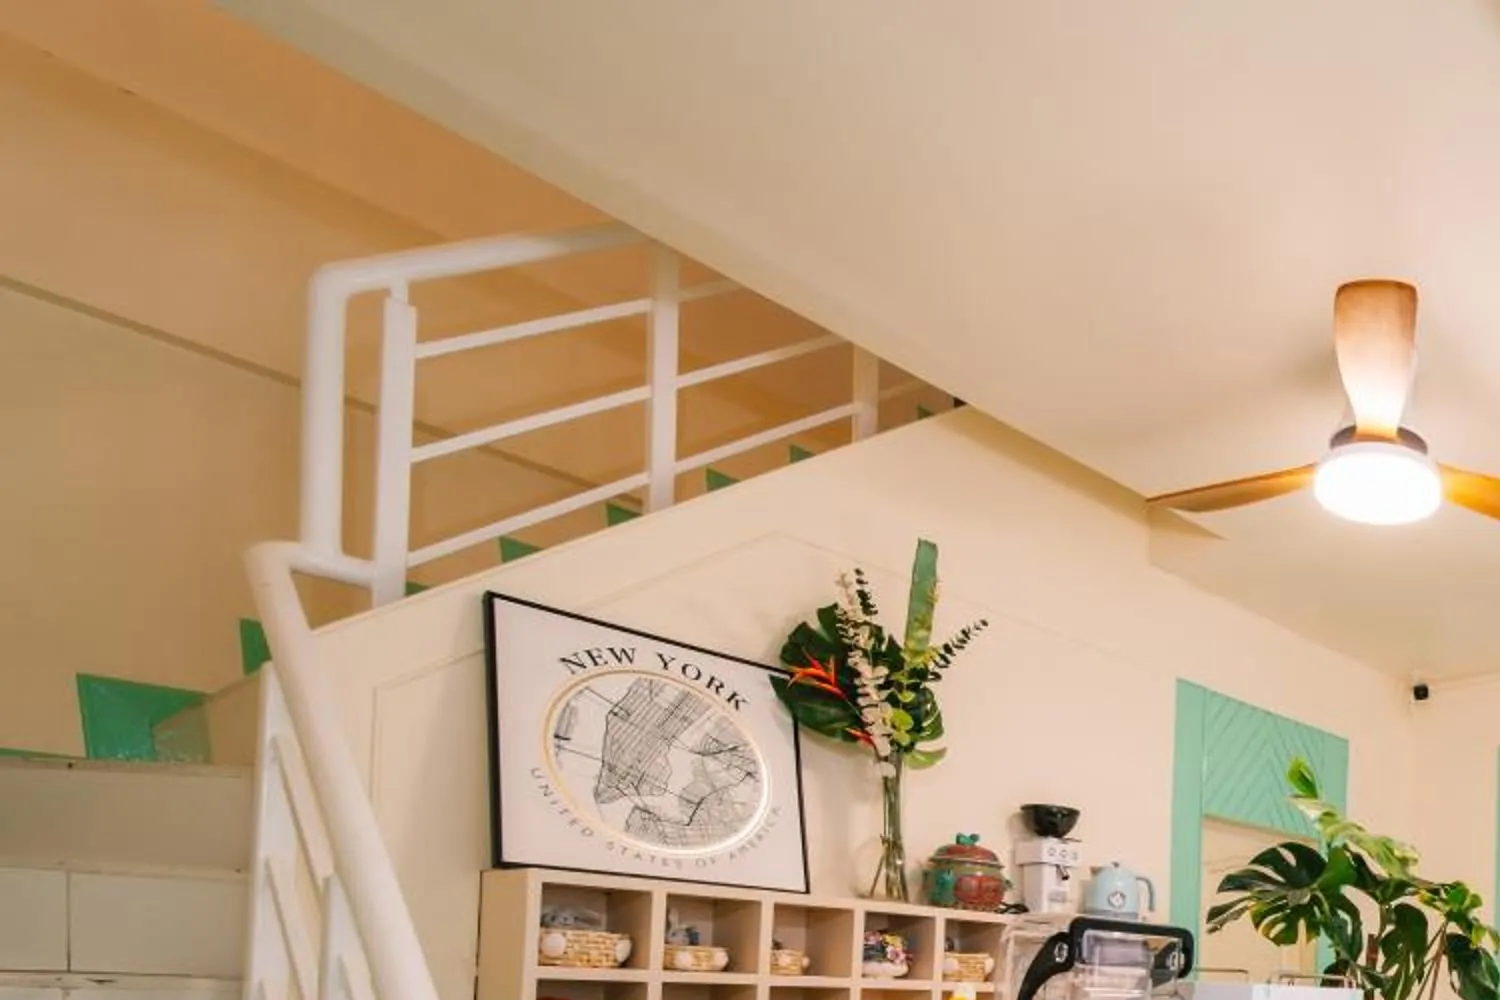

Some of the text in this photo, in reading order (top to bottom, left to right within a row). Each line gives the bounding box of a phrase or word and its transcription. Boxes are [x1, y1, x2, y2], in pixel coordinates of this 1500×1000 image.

[559, 647, 749, 711] NEW YORK
[530, 768, 594, 836] UNITED
[605, 841, 683, 870] STATES
[695, 856, 716, 868] OF
